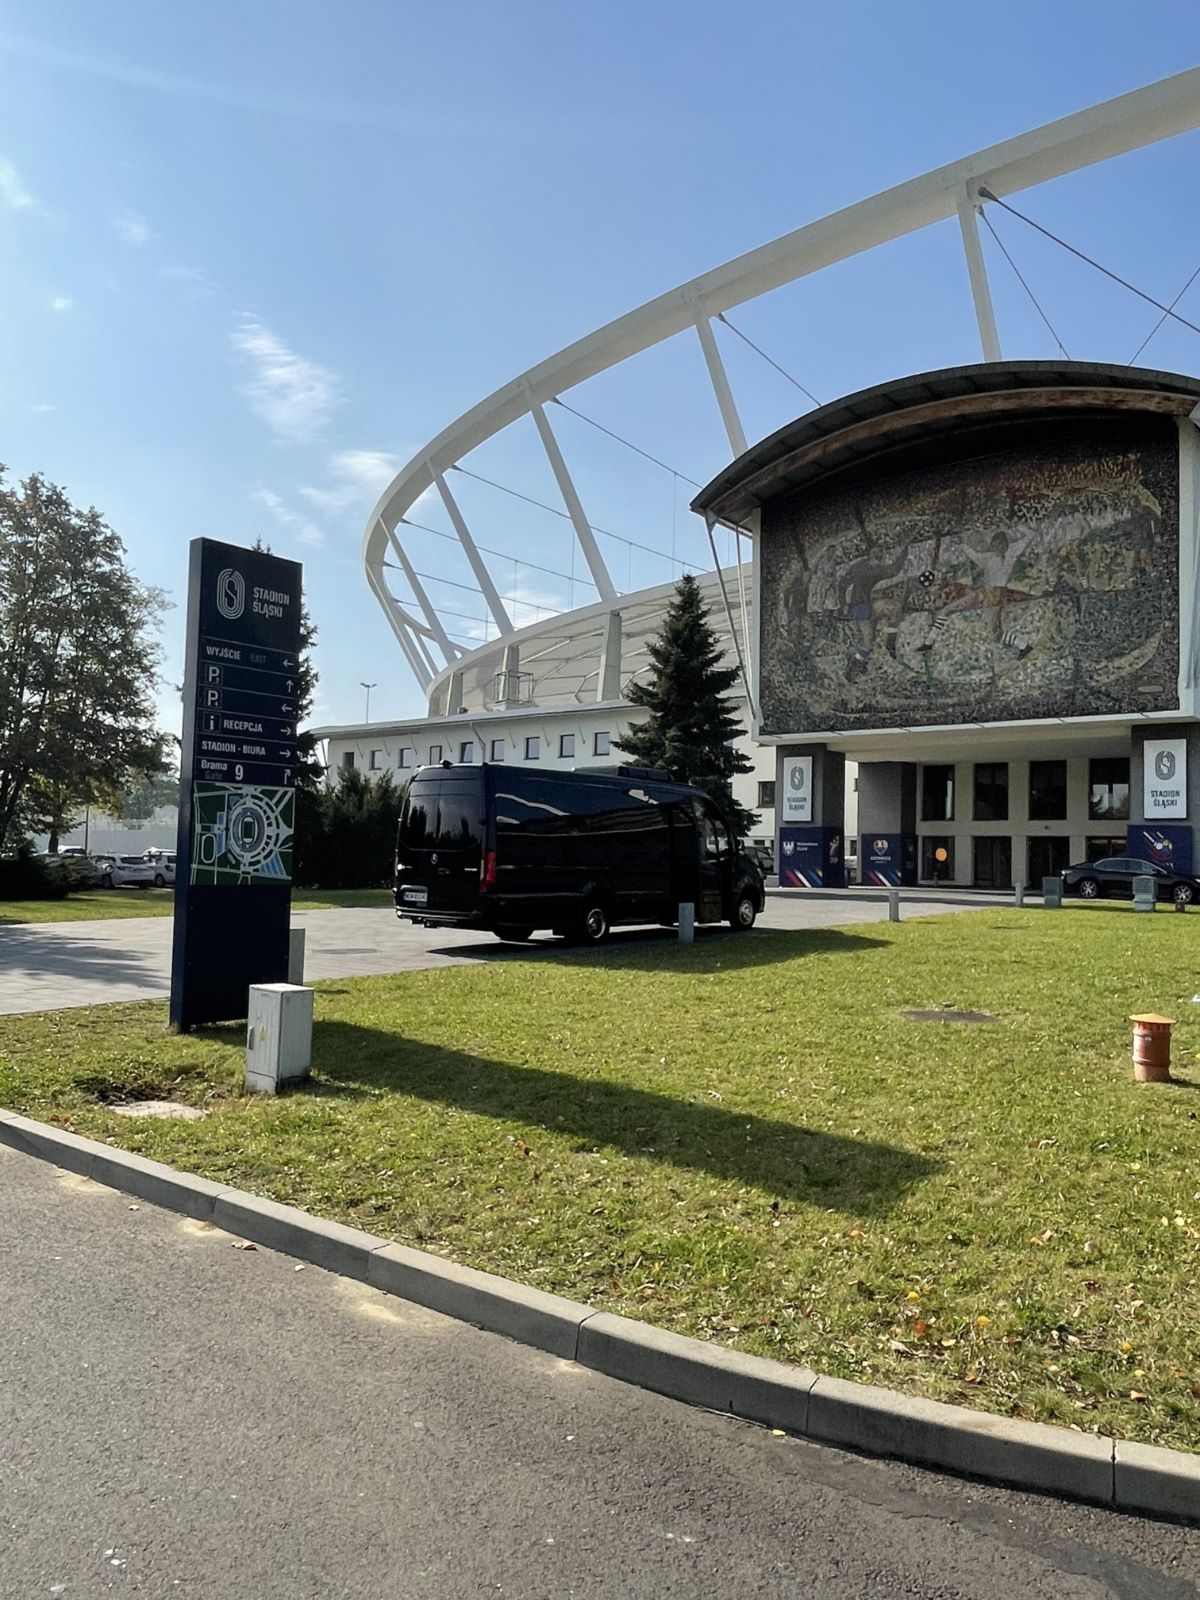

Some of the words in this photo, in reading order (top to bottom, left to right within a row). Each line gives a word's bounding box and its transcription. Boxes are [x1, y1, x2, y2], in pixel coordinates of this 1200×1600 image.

[253, 586, 290, 605] STADION
[252, 600, 283, 619] ŚLĄSKI
[206, 645, 241, 660] WYJŚCIE
[223, 718, 263, 733] RECEPCJA
[201, 740, 236, 753] STADION
[242, 744, 266, 756] BIURA
[201, 759, 228, 771] Brama
[234, 764, 244, 781] 9
[1150, 790, 1180, 798] STADION
[1153, 798, 1178, 809] ŚLĄSKI
